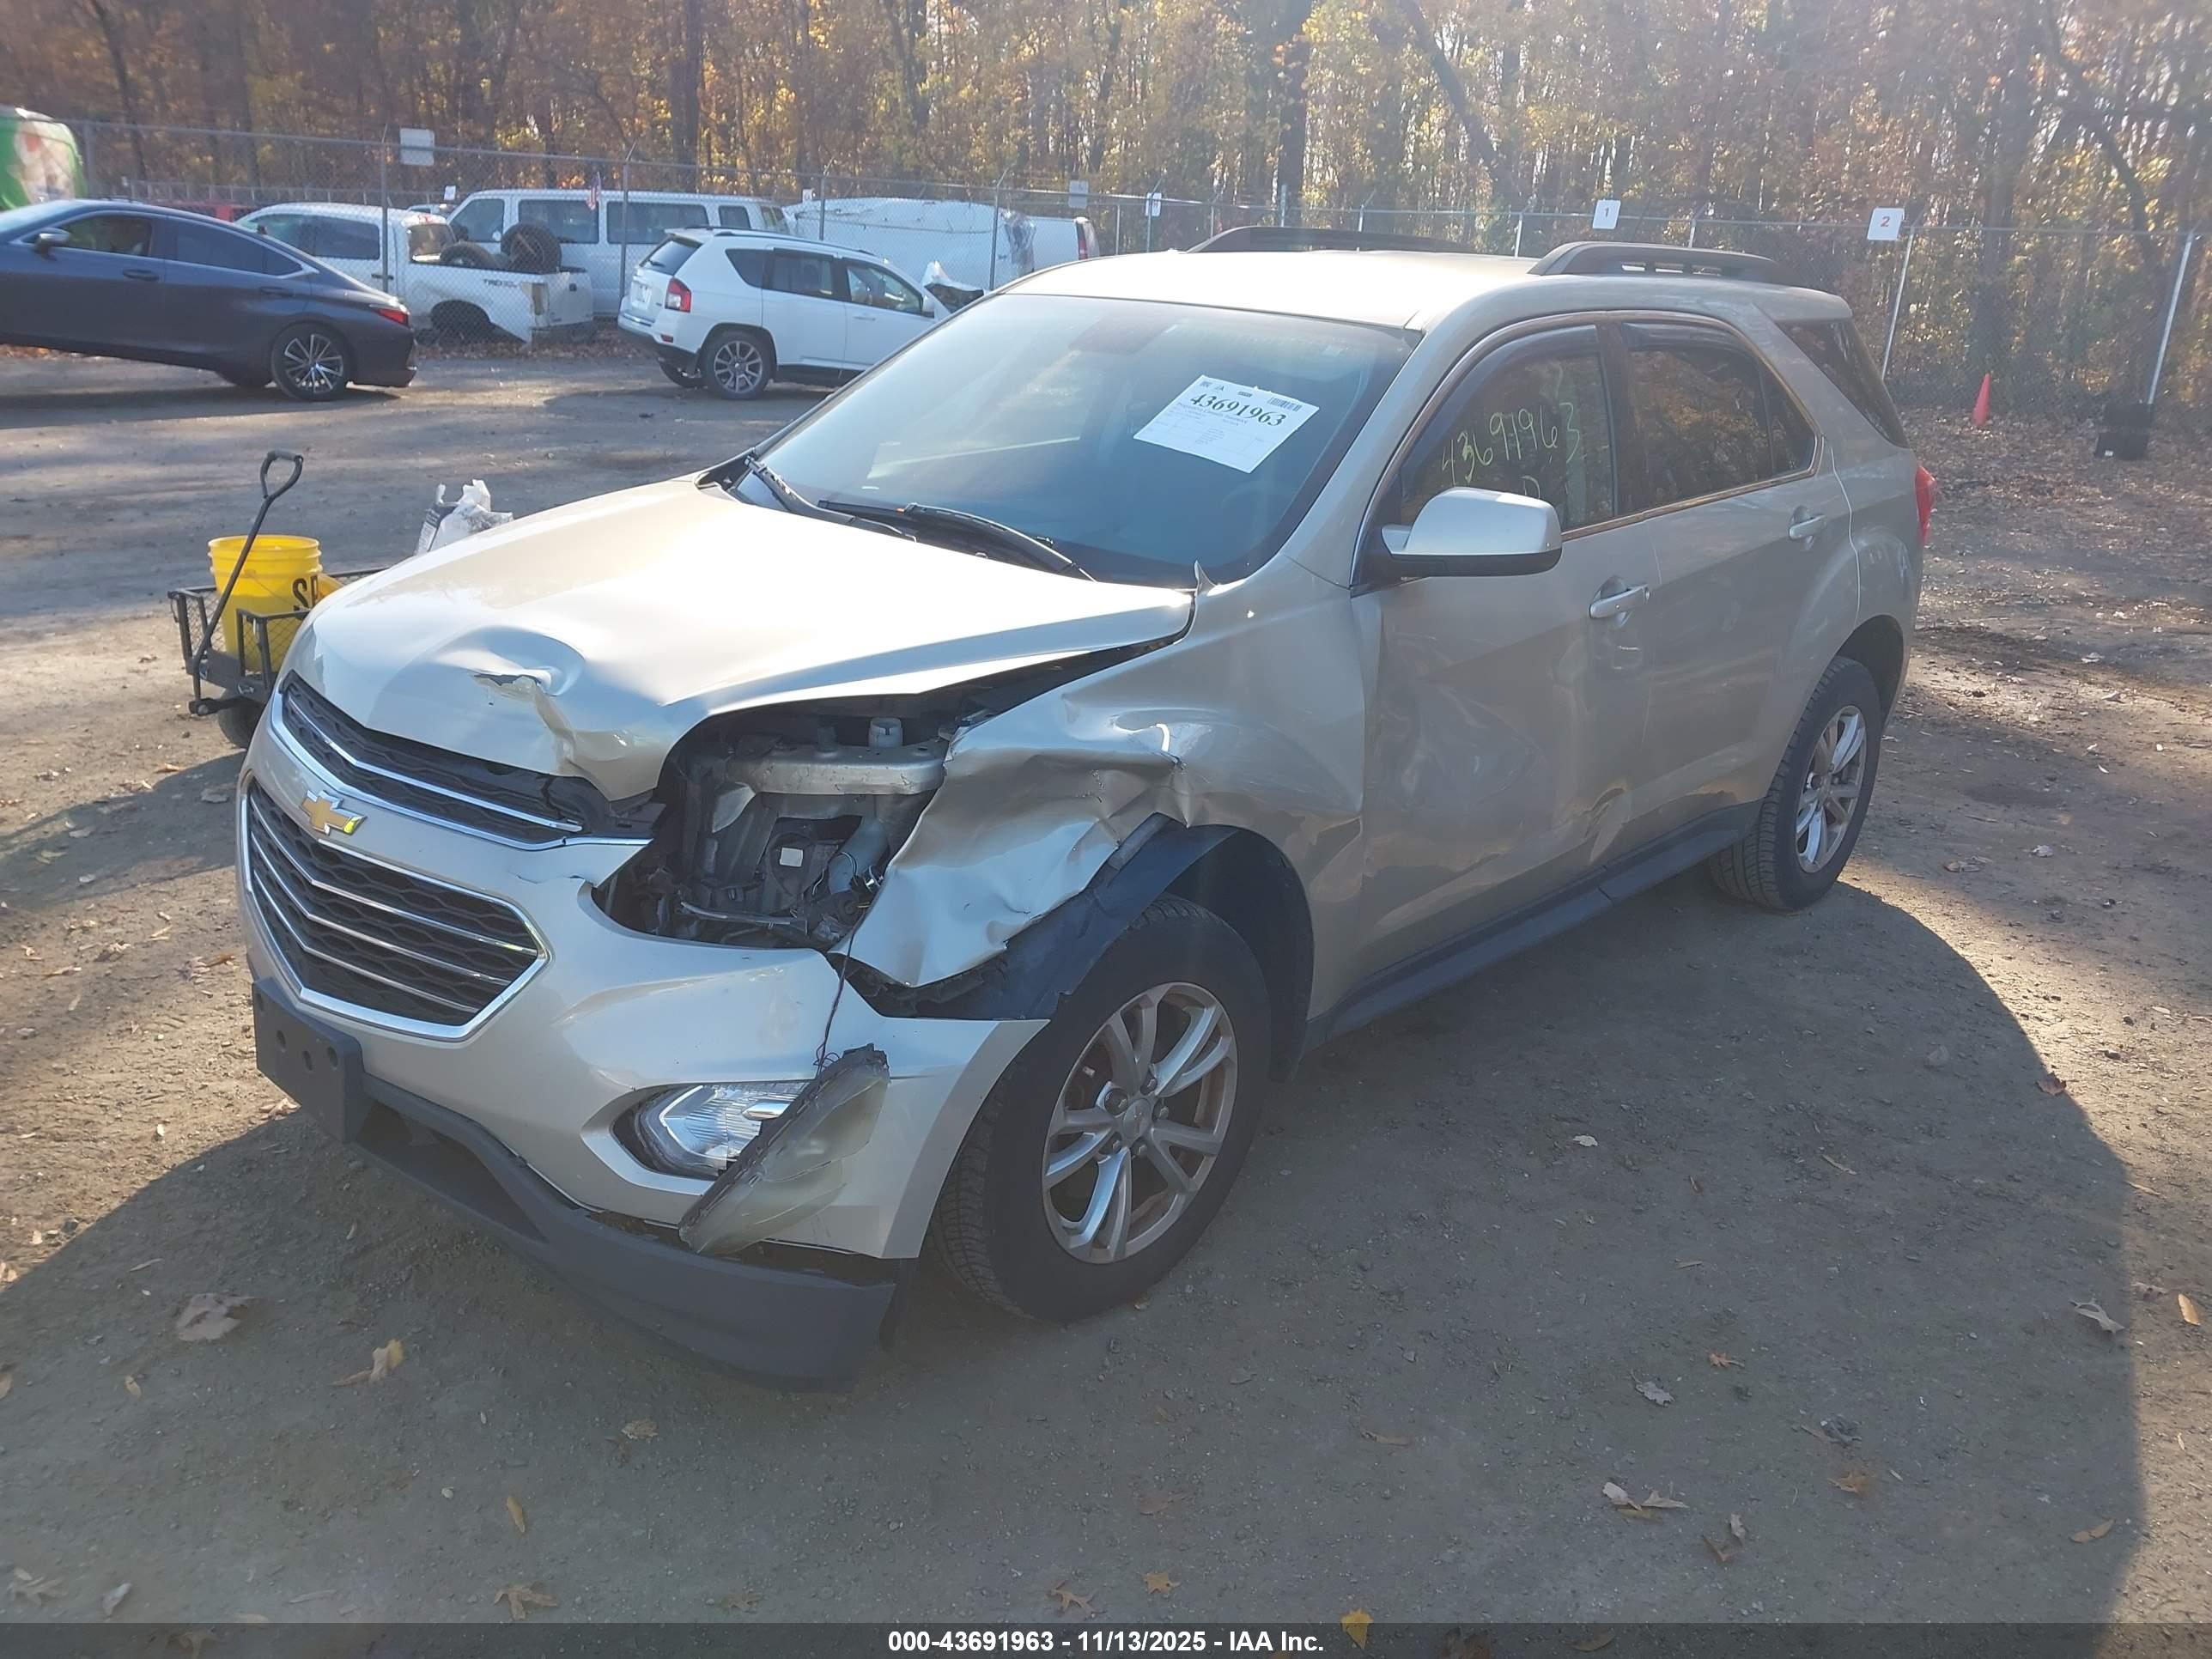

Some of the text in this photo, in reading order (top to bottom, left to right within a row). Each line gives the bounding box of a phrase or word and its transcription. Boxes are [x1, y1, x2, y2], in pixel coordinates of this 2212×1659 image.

[1881, 216, 1891, 228] 2
[1190, 393, 1287, 426] 43691963
[1442, 402, 1581, 487] 43691963
